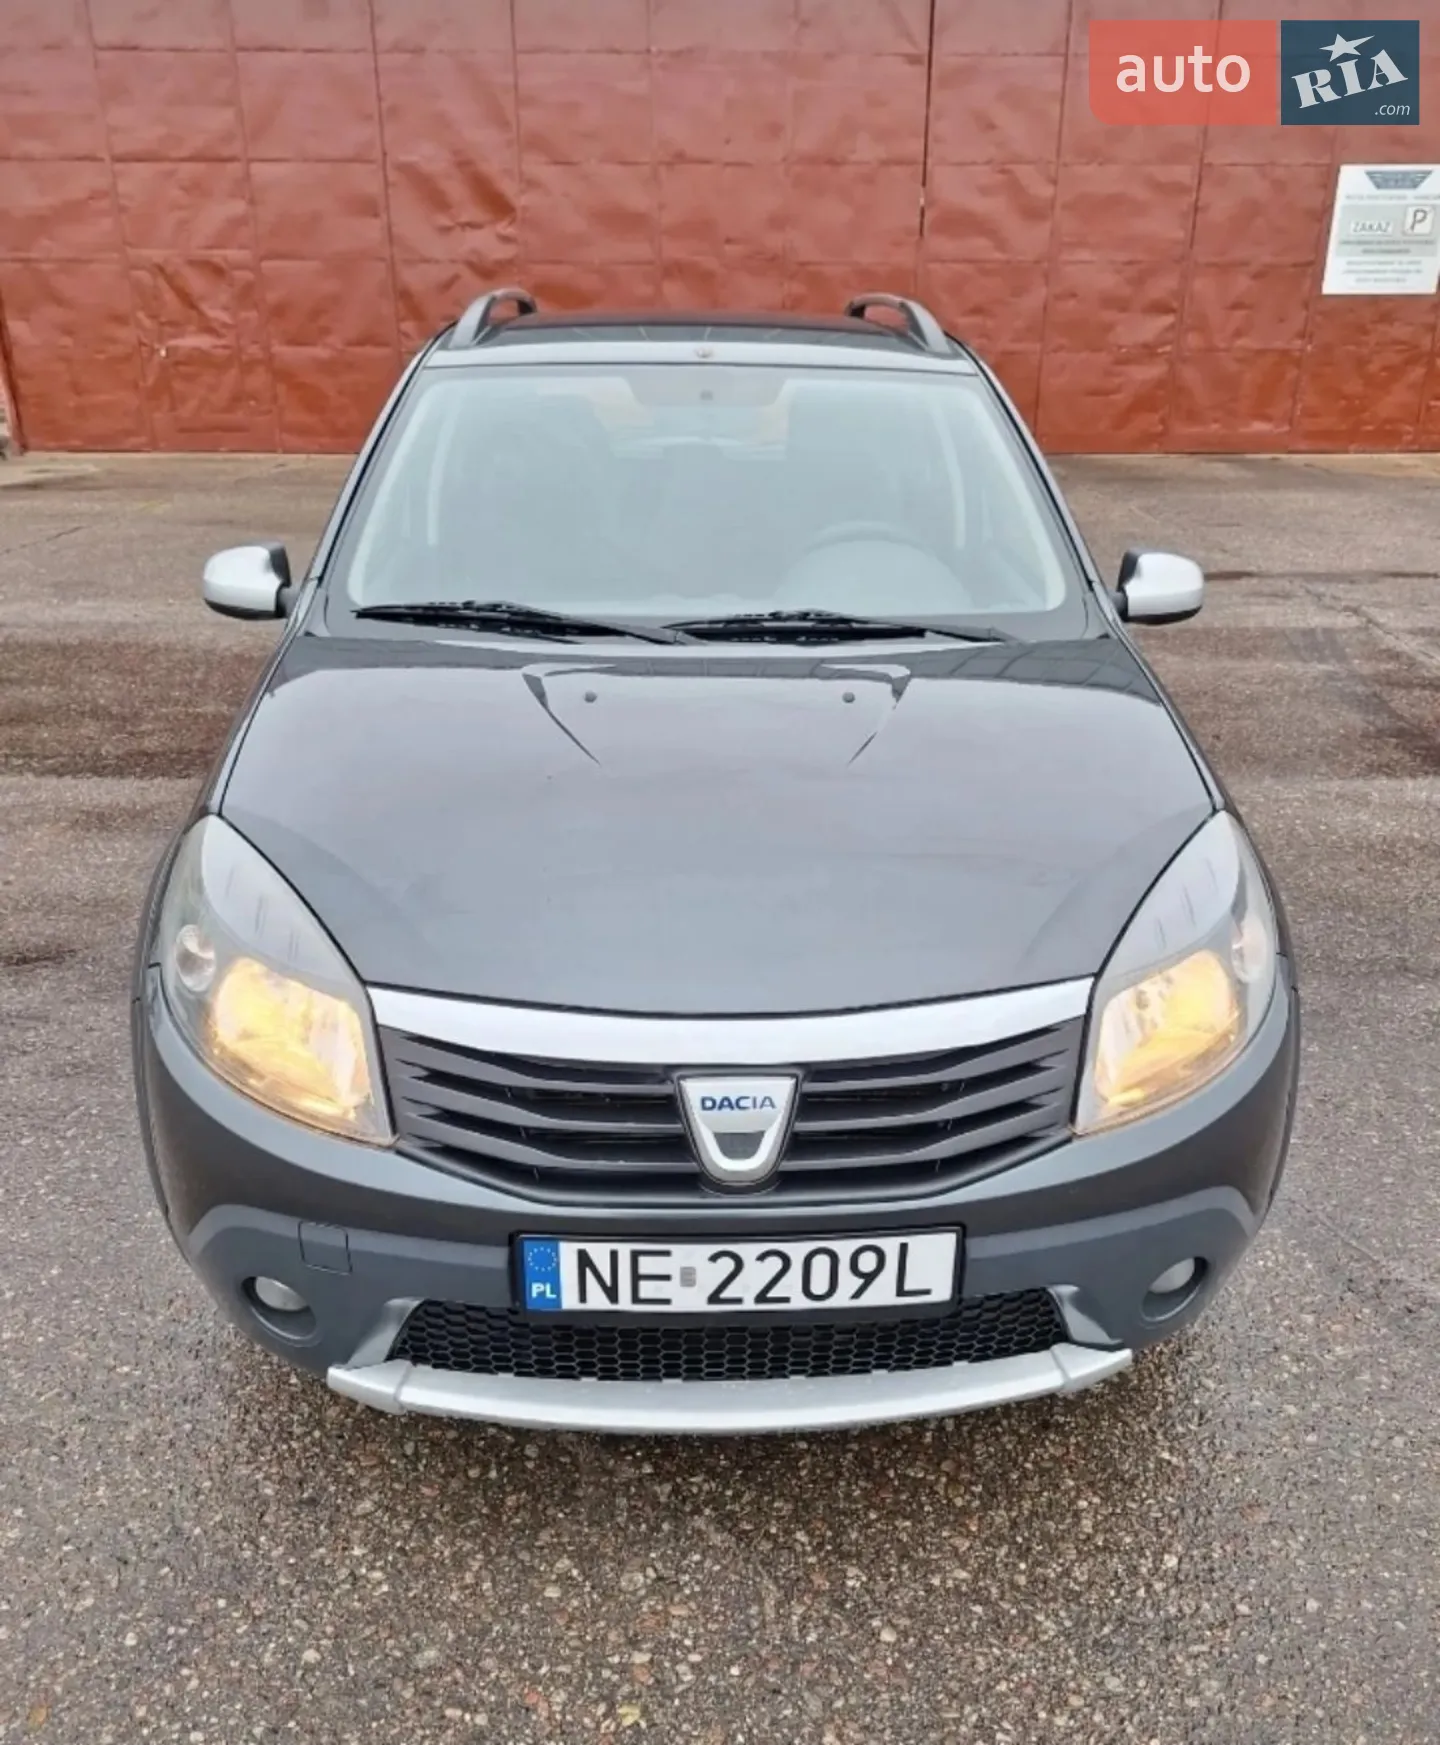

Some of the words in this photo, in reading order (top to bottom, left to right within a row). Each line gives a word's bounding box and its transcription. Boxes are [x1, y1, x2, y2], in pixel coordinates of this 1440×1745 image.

[1409, 208, 1428, 232] P
[700, 1095, 777, 1112] DACIA
[576, 1248, 673, 1305] NE
[706, 1241, 933, 1305] 2209L
[531, 1283, 557, 1299] PL
